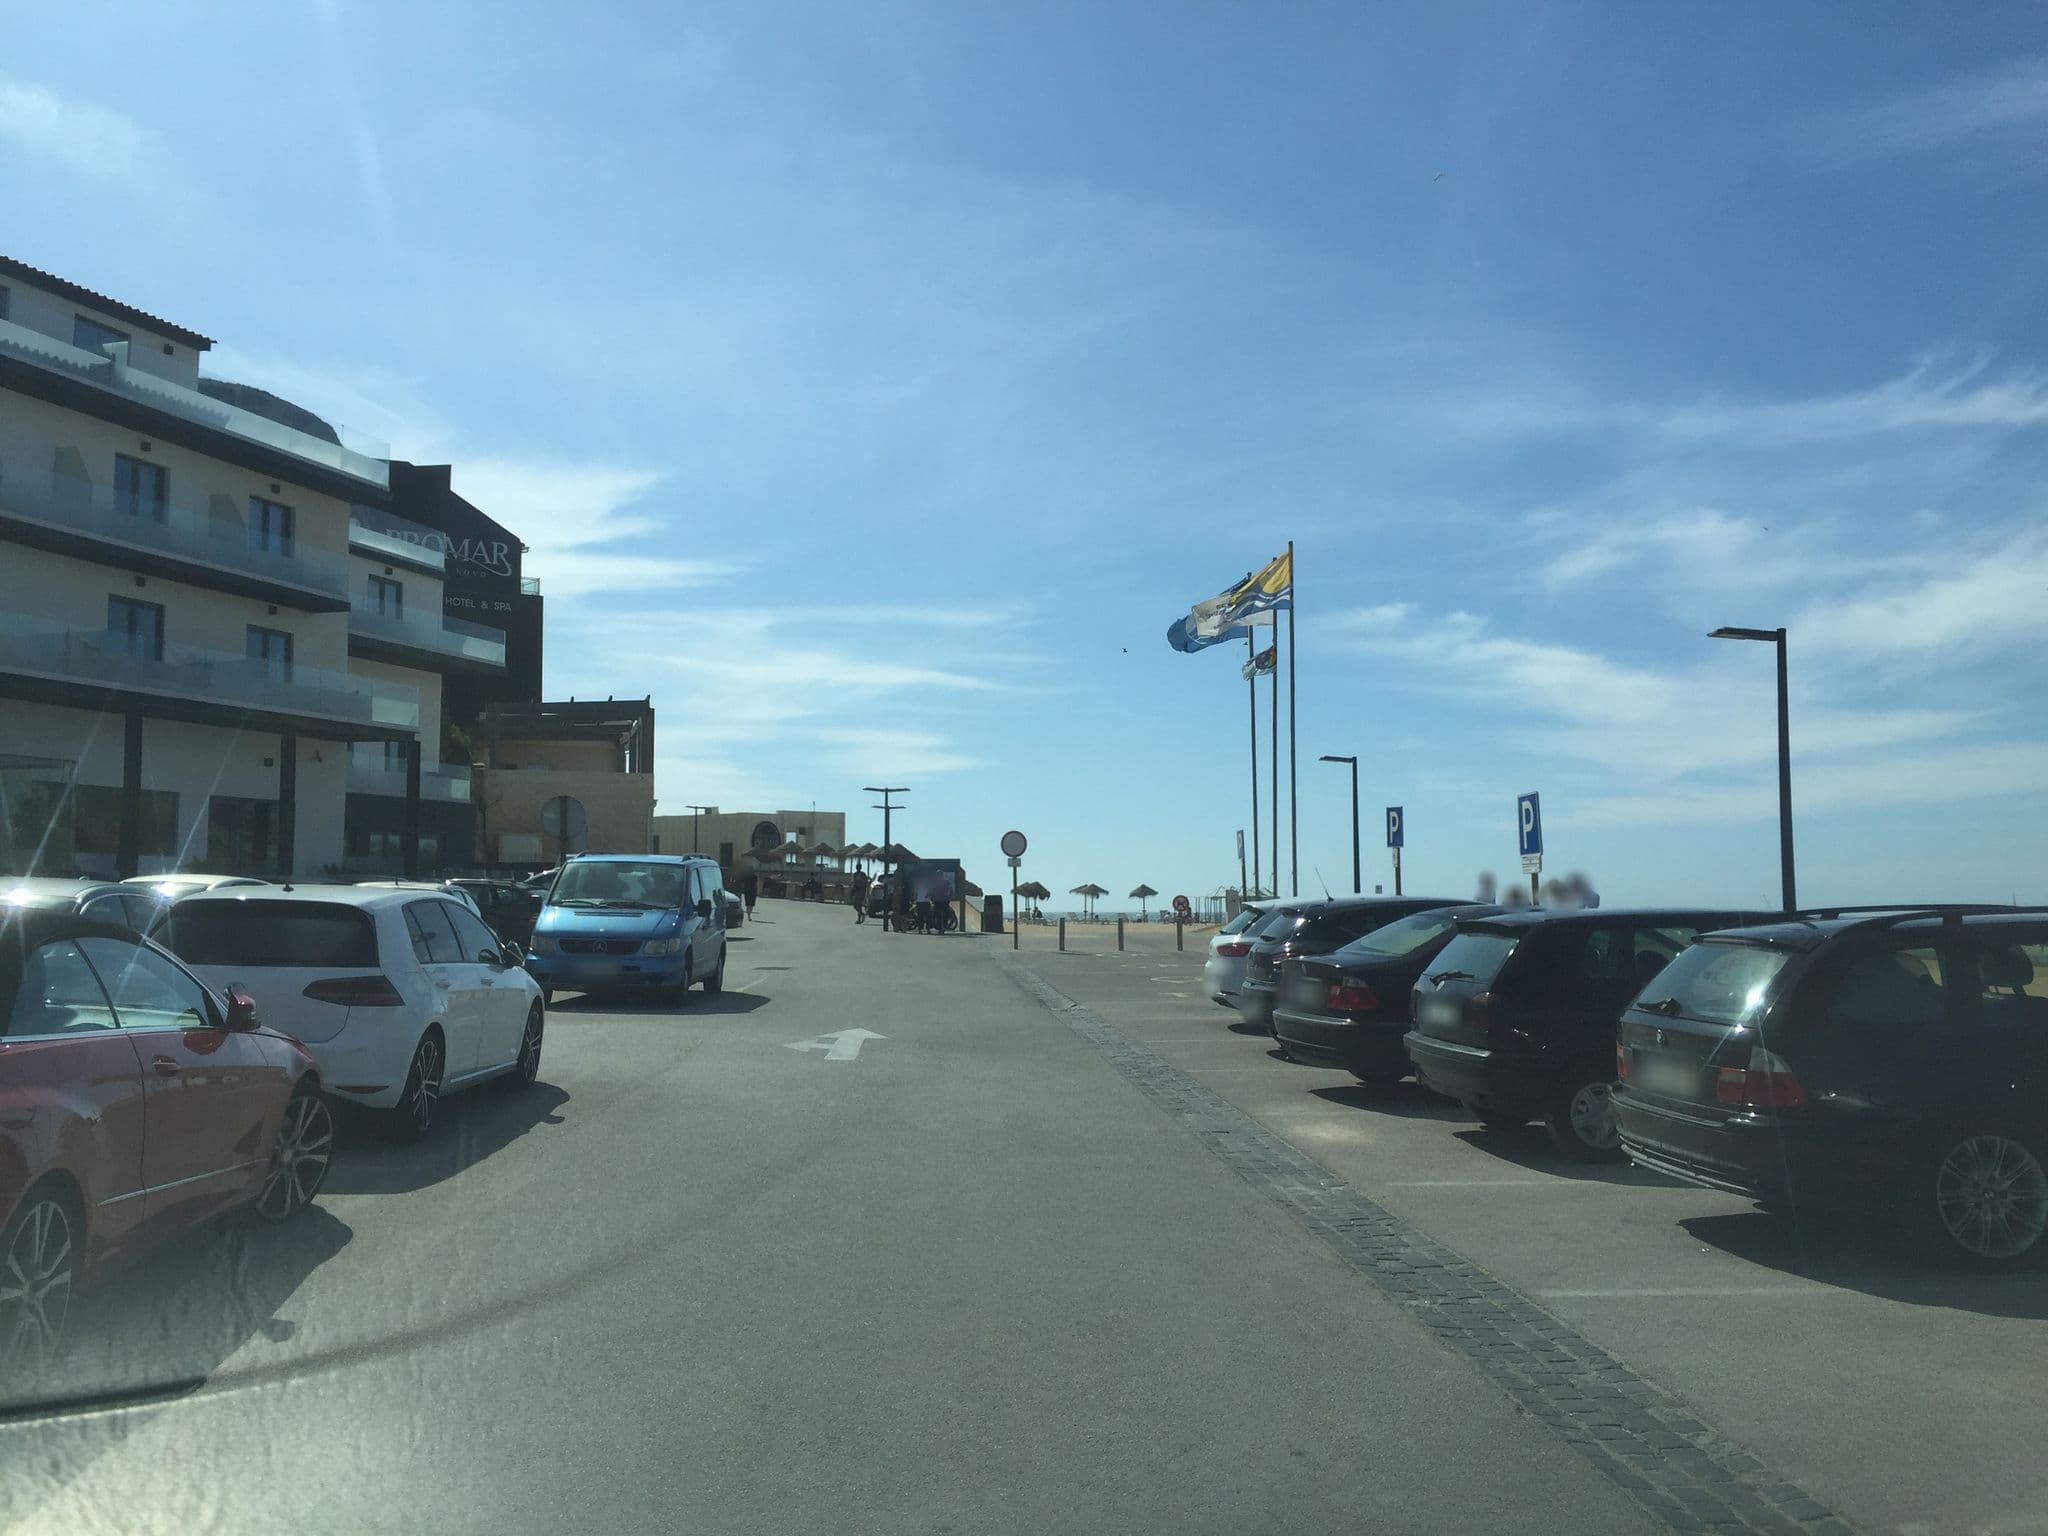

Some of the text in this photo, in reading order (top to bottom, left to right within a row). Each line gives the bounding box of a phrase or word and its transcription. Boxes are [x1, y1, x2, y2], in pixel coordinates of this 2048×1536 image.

[445, 595, 512, 611] HOTEL & SPA
[1389, 811, 1399, 844] P
[1522, 800, 1534, 849] P
